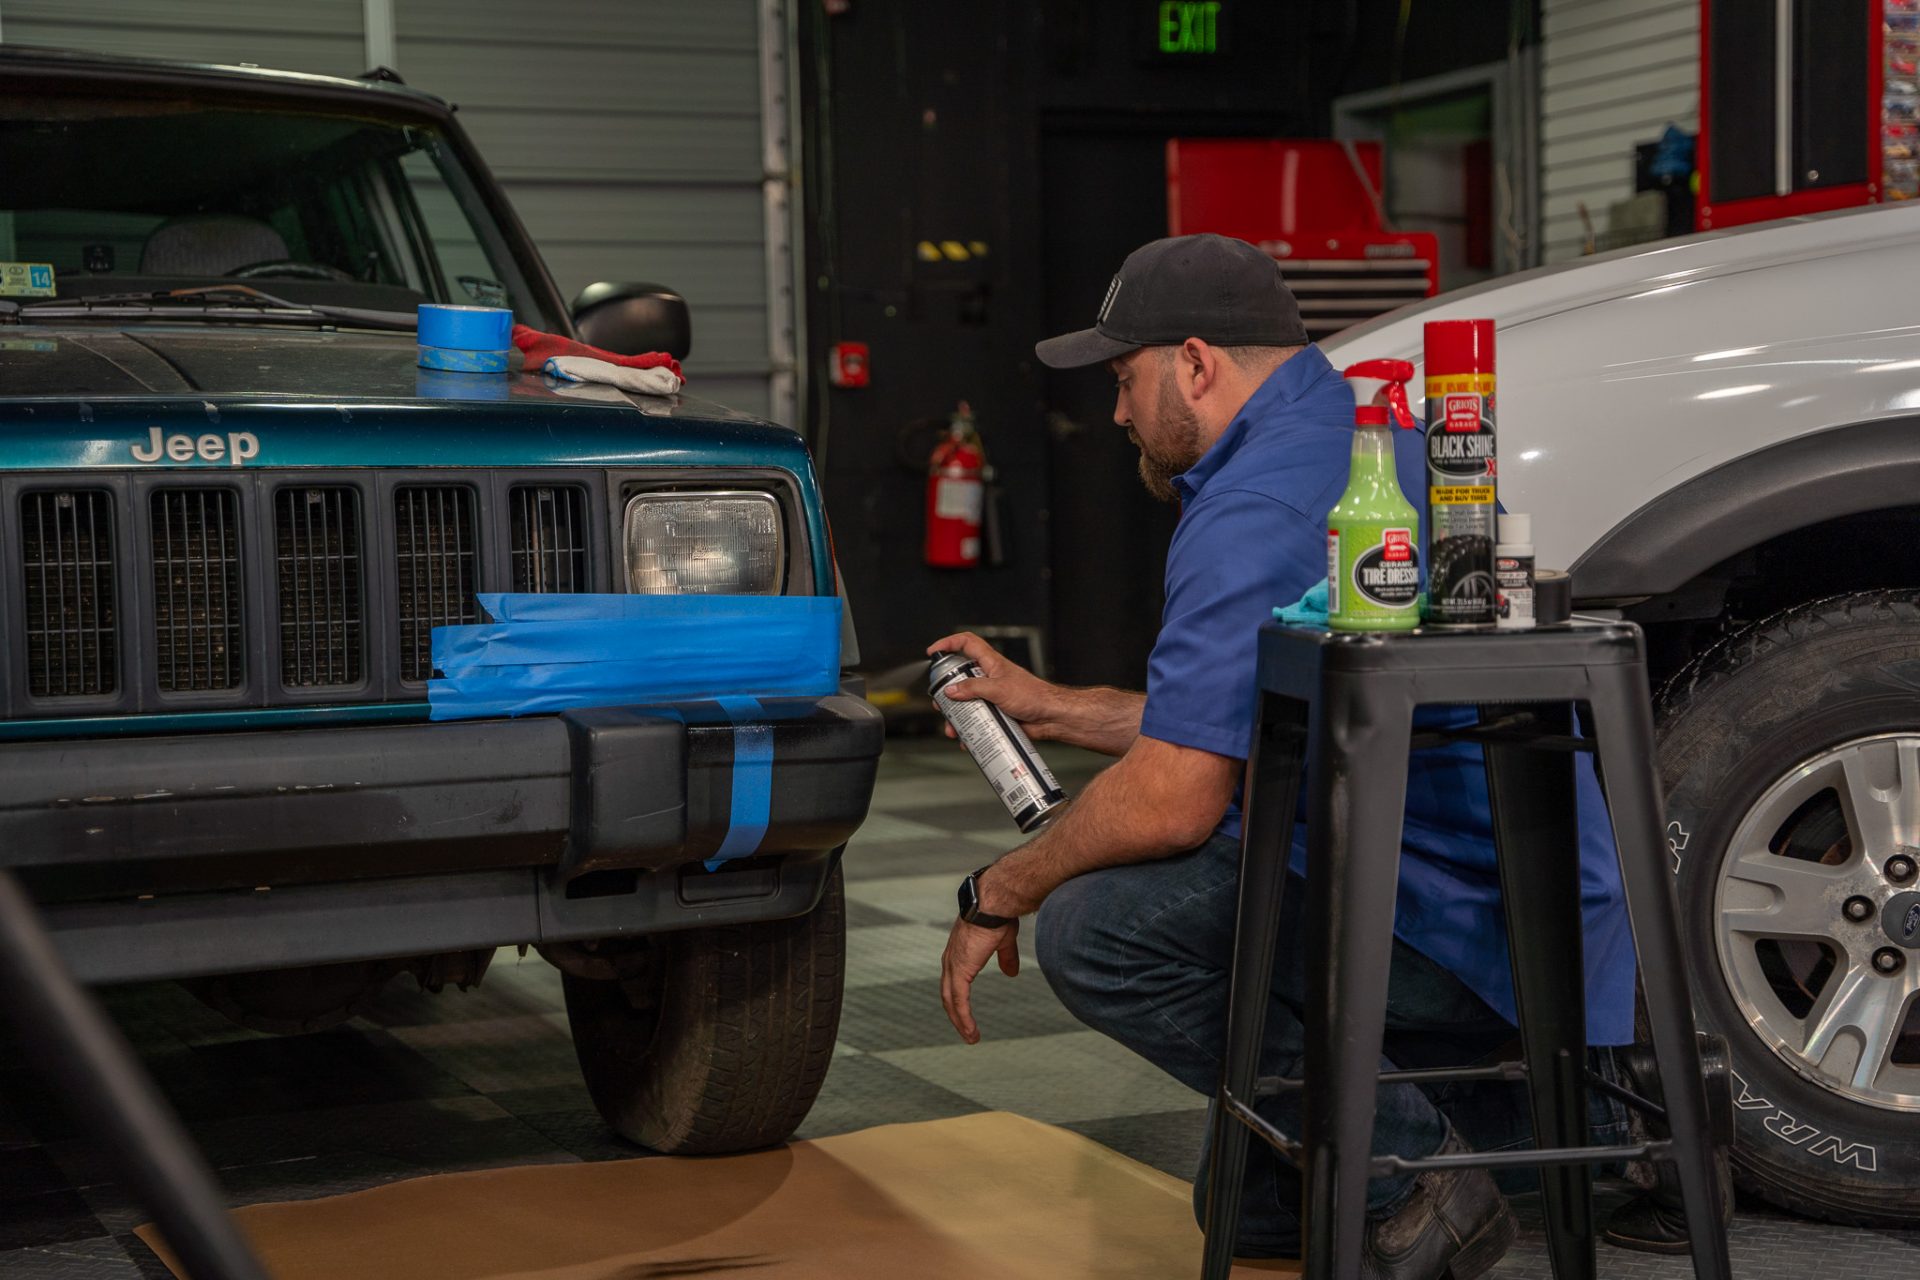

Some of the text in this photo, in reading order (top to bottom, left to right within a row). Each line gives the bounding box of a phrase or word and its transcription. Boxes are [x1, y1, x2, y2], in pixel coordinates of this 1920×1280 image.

[1159, 2, 1221, 53] EXIT
[32, 271, 51, 287] 14
[131, 426, 260, 465] Jeep
[1431, 434, 1494, 458] BLACK SHINE
[1363, 568, 1386, 585] TIRE
[1667, 821, 1689, 874] R
[1732, 1069, 1877, 1172] WRA
